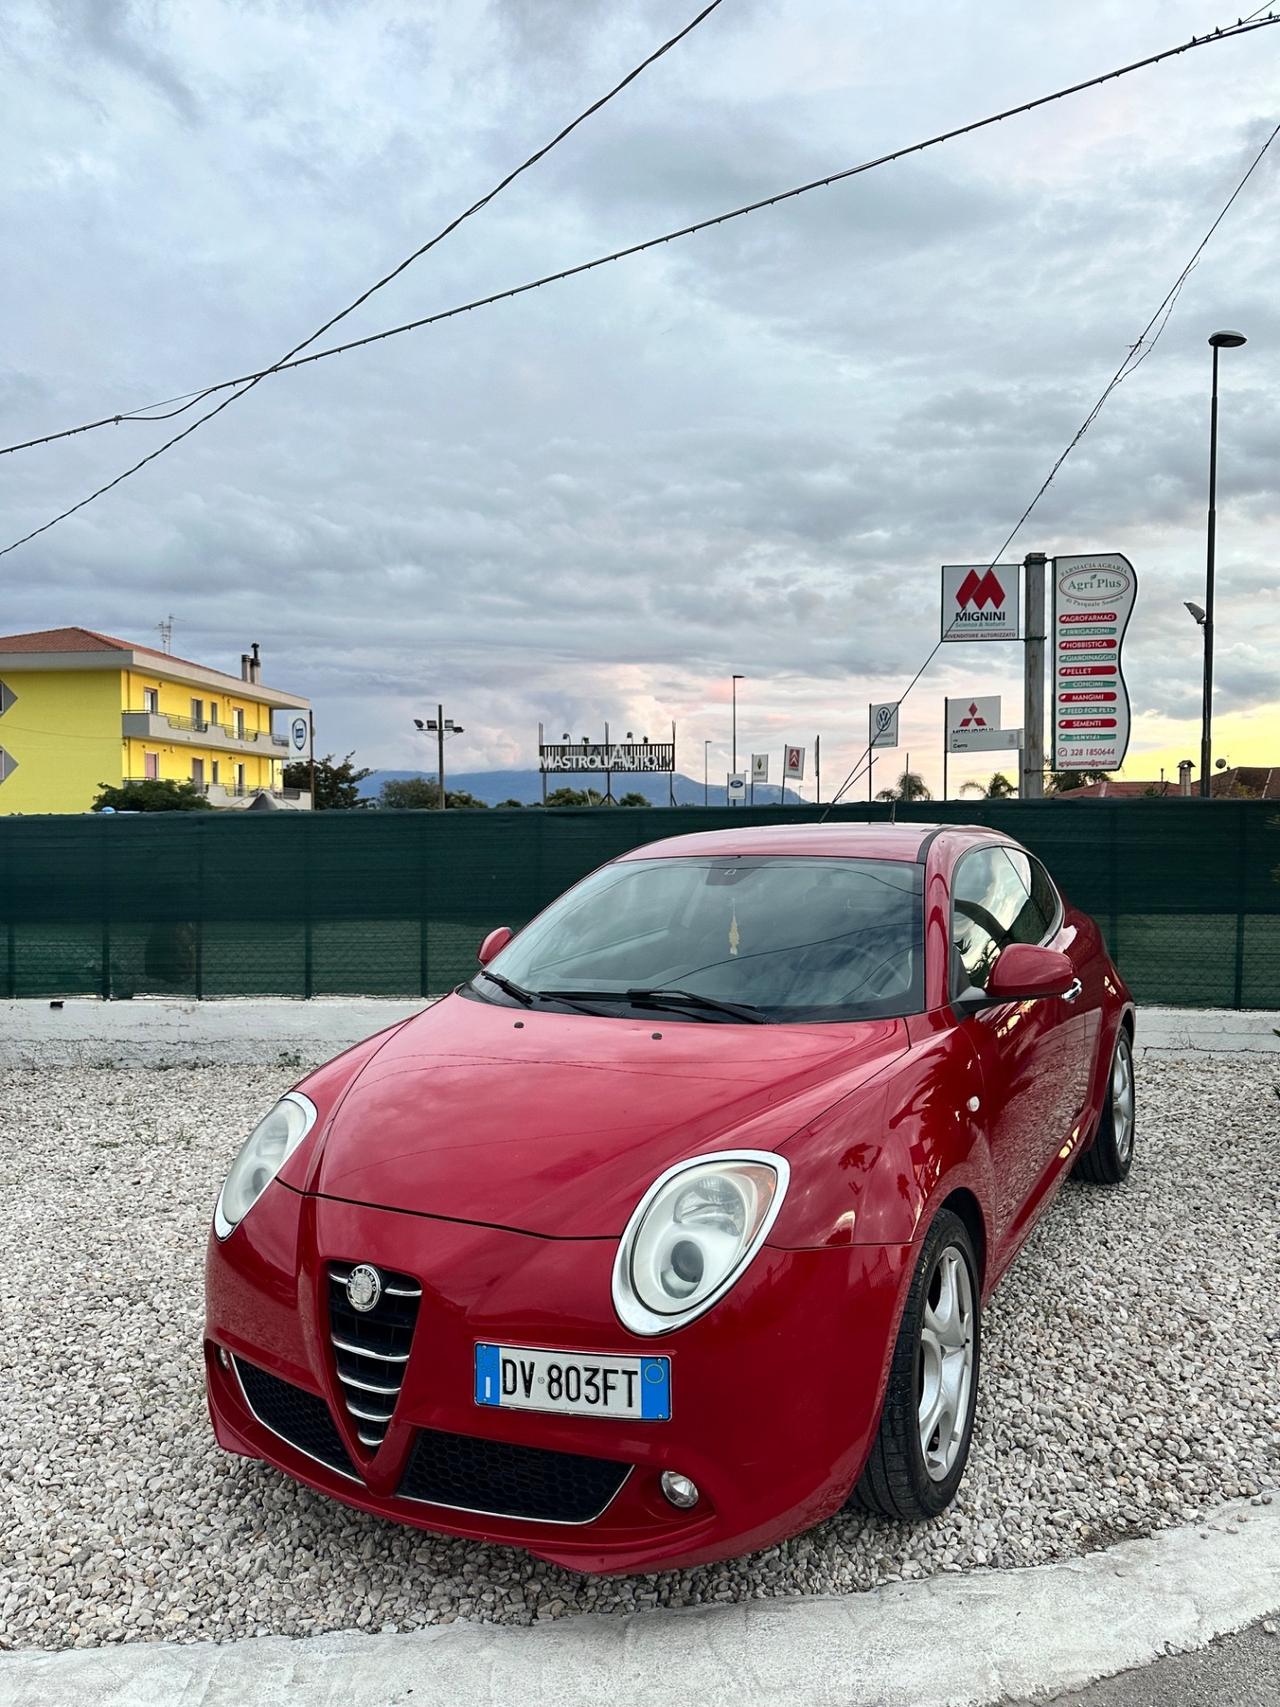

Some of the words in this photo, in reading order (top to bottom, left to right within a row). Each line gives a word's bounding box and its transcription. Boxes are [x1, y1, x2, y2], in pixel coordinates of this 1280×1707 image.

[1061, 563, 1097, 577] FARMACIA
[1097, 562, 1128, 575] AGRARIA
[1068, 579, 1094, 592] Agri
[1097, 578, 1122, 588] Plus
[955, 611, 1006, 622] MIGNINI
[1065, 614, 1115, 622] AGROFARMACI
[1066, 641, 1107, 649] HOBBISTICA
[1066, 654, 1115, 662] GIARDINAGGIO
[1072, 693, 1104, 701] MANGIMI
[1070, 748, 1083, 757] 328
[1086, 748, 1115, 756] 1850644
[502, 1358, 535, 1399] DV
[547, 1363, 639, 1408] 803FT
